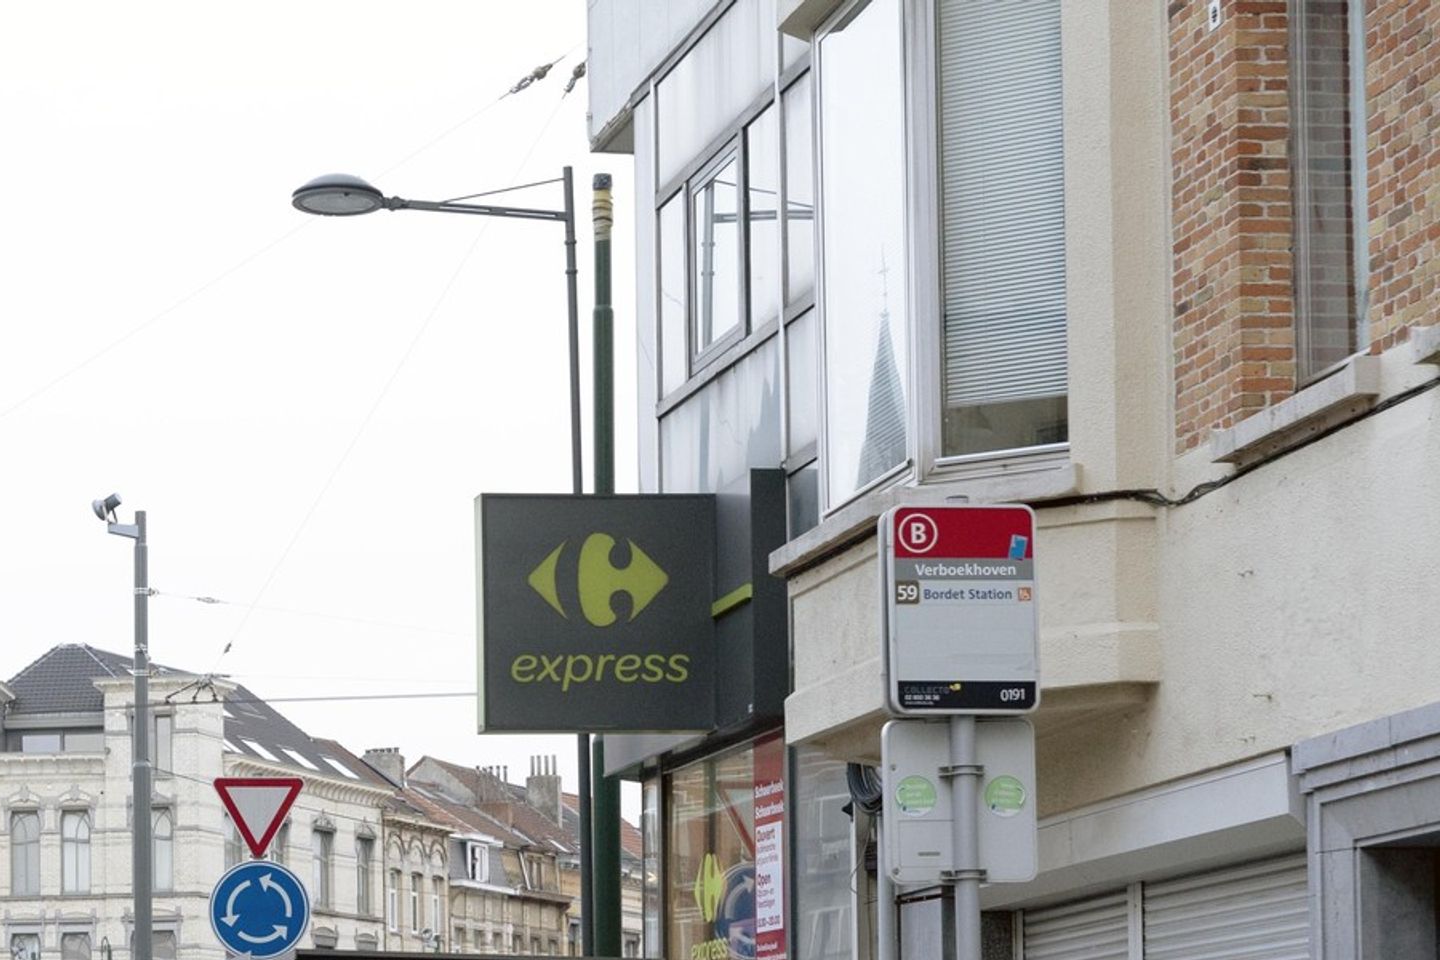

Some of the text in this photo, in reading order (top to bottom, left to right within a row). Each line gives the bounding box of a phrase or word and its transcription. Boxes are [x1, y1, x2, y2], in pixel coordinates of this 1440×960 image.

[910, 522, 926, 544] B
[914, 563, 1017, 576] Verboekhoven
[897, 585, 1012, 600] 59 Bordet Station
[511, 653, 690, 692] express
[1000, 688, 1025, 702] 0191
